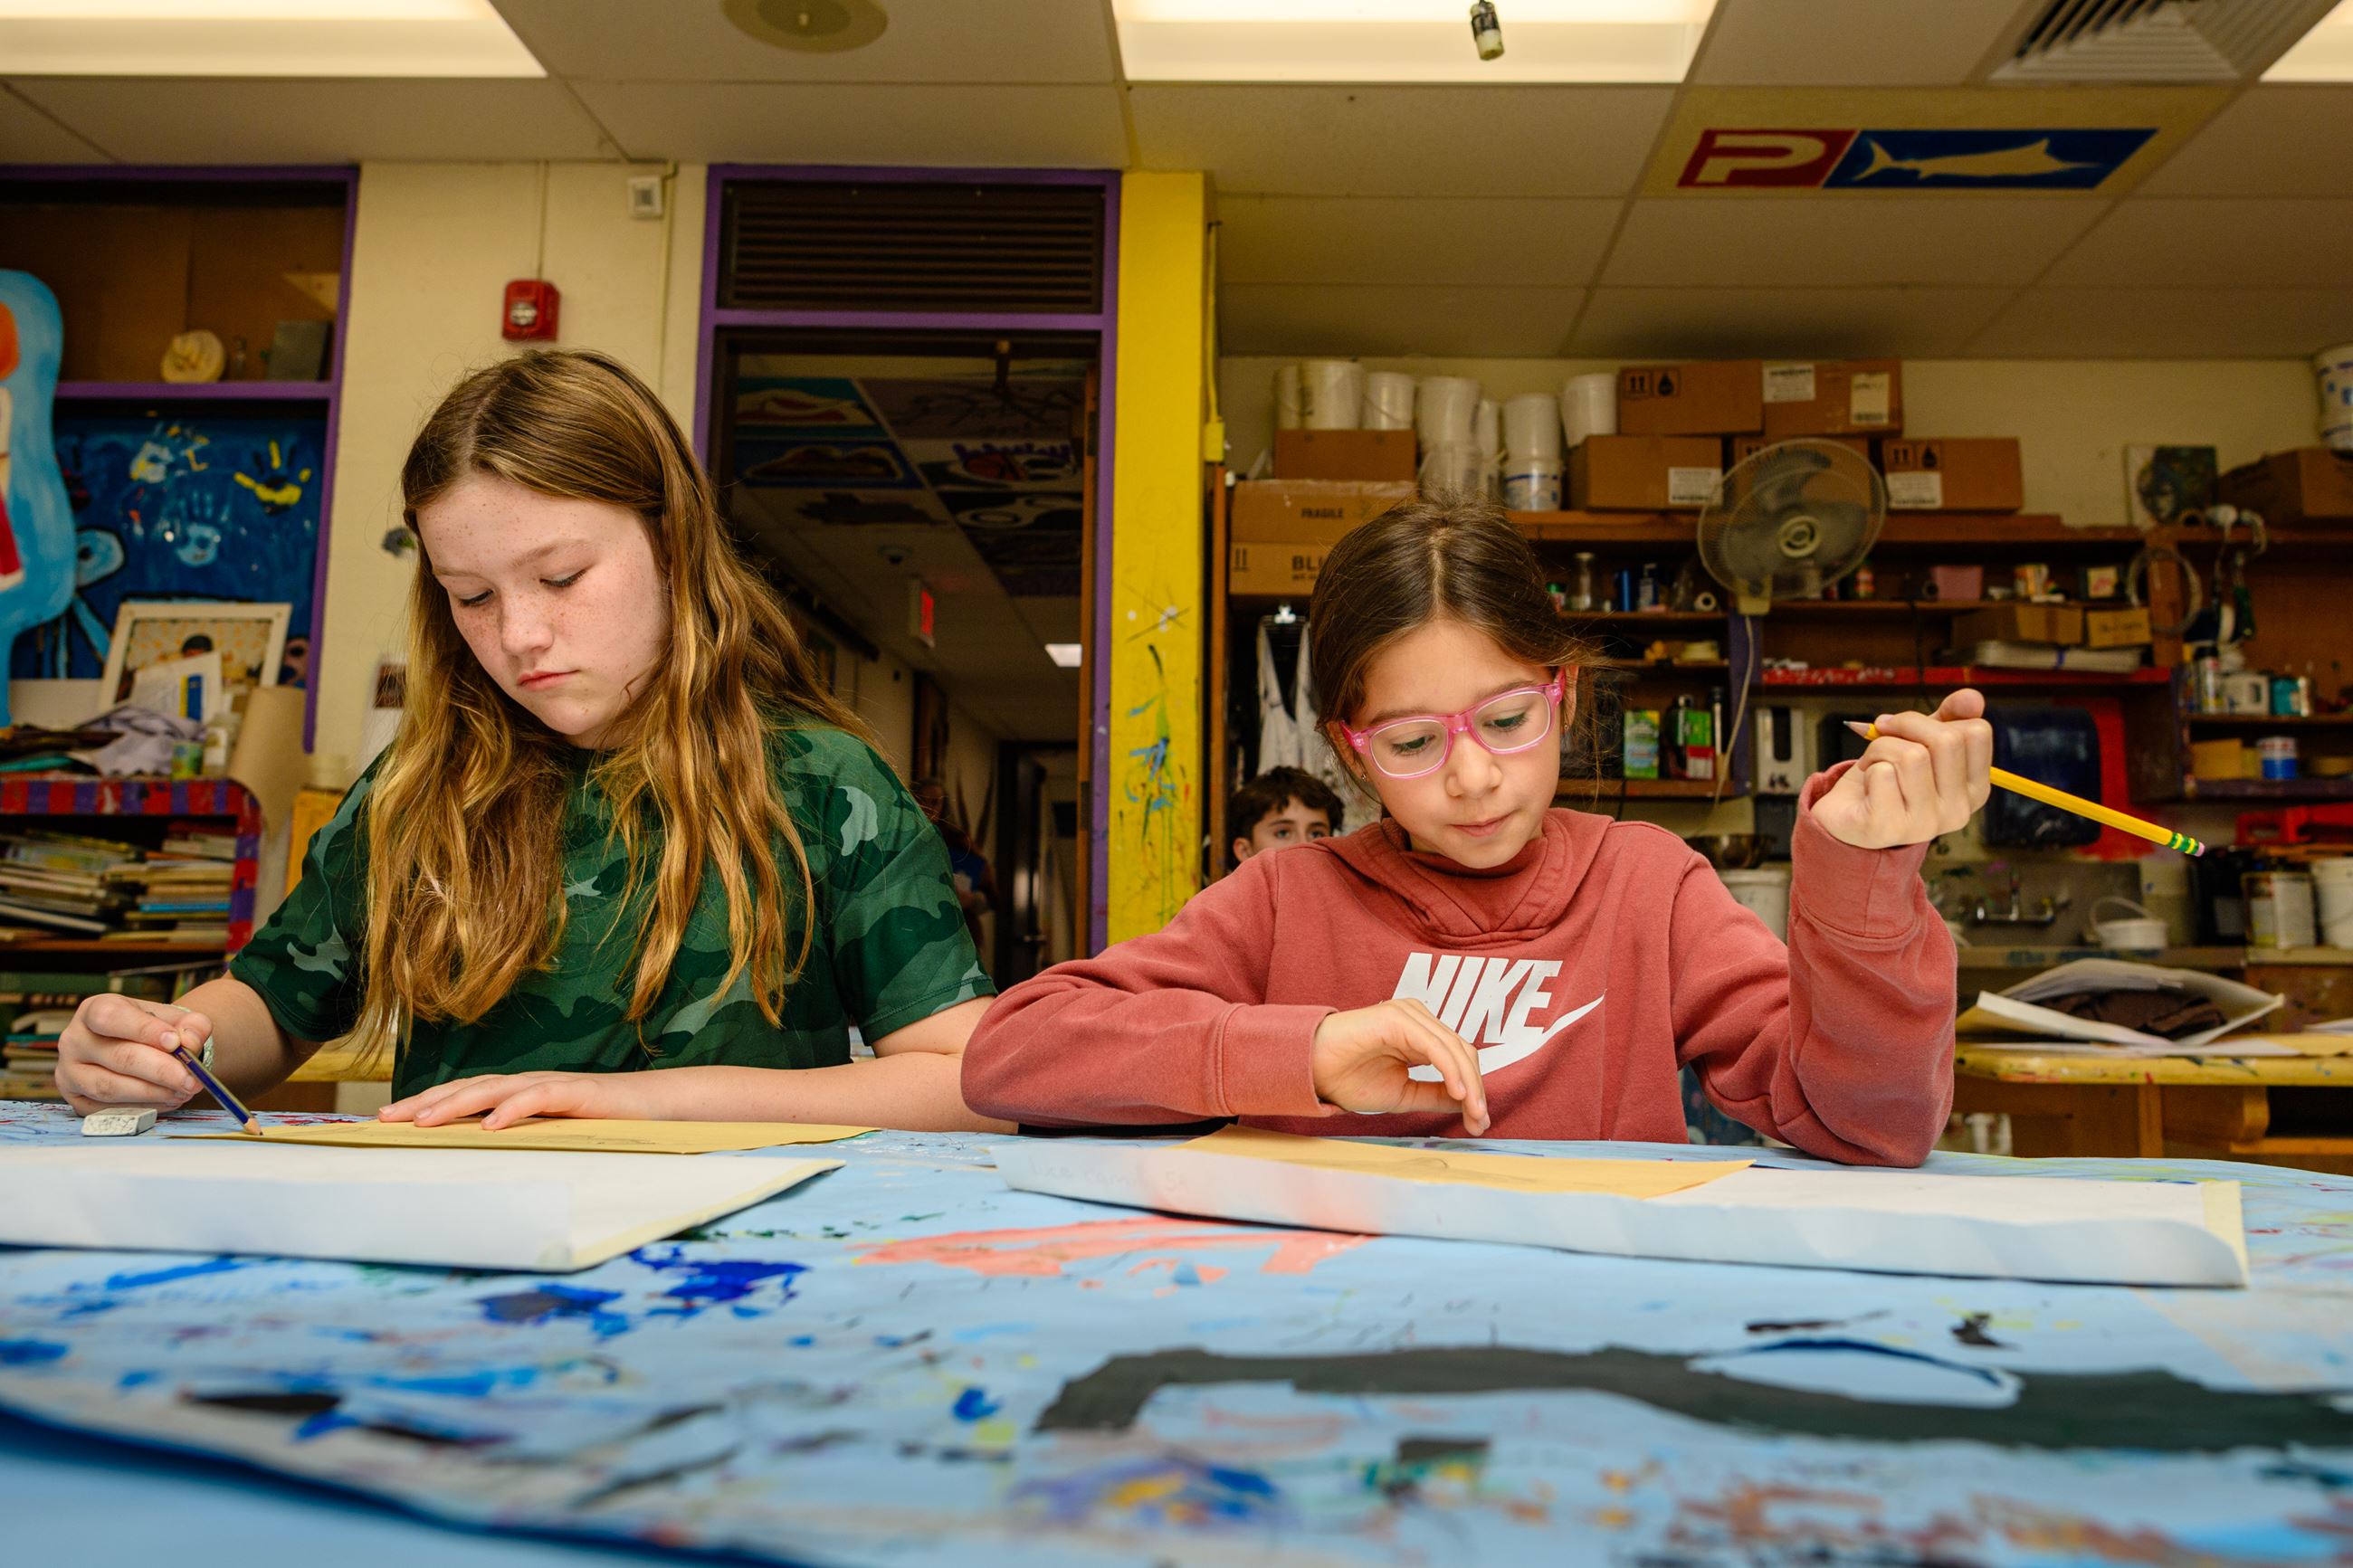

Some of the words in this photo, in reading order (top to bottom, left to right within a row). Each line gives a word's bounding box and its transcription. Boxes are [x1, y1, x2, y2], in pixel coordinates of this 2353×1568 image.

[1694, 132, 1826, 183] P
[1301, 508, 1344, 519] FRAGILE
[1391, 952, 1564, 1044] NIKE
